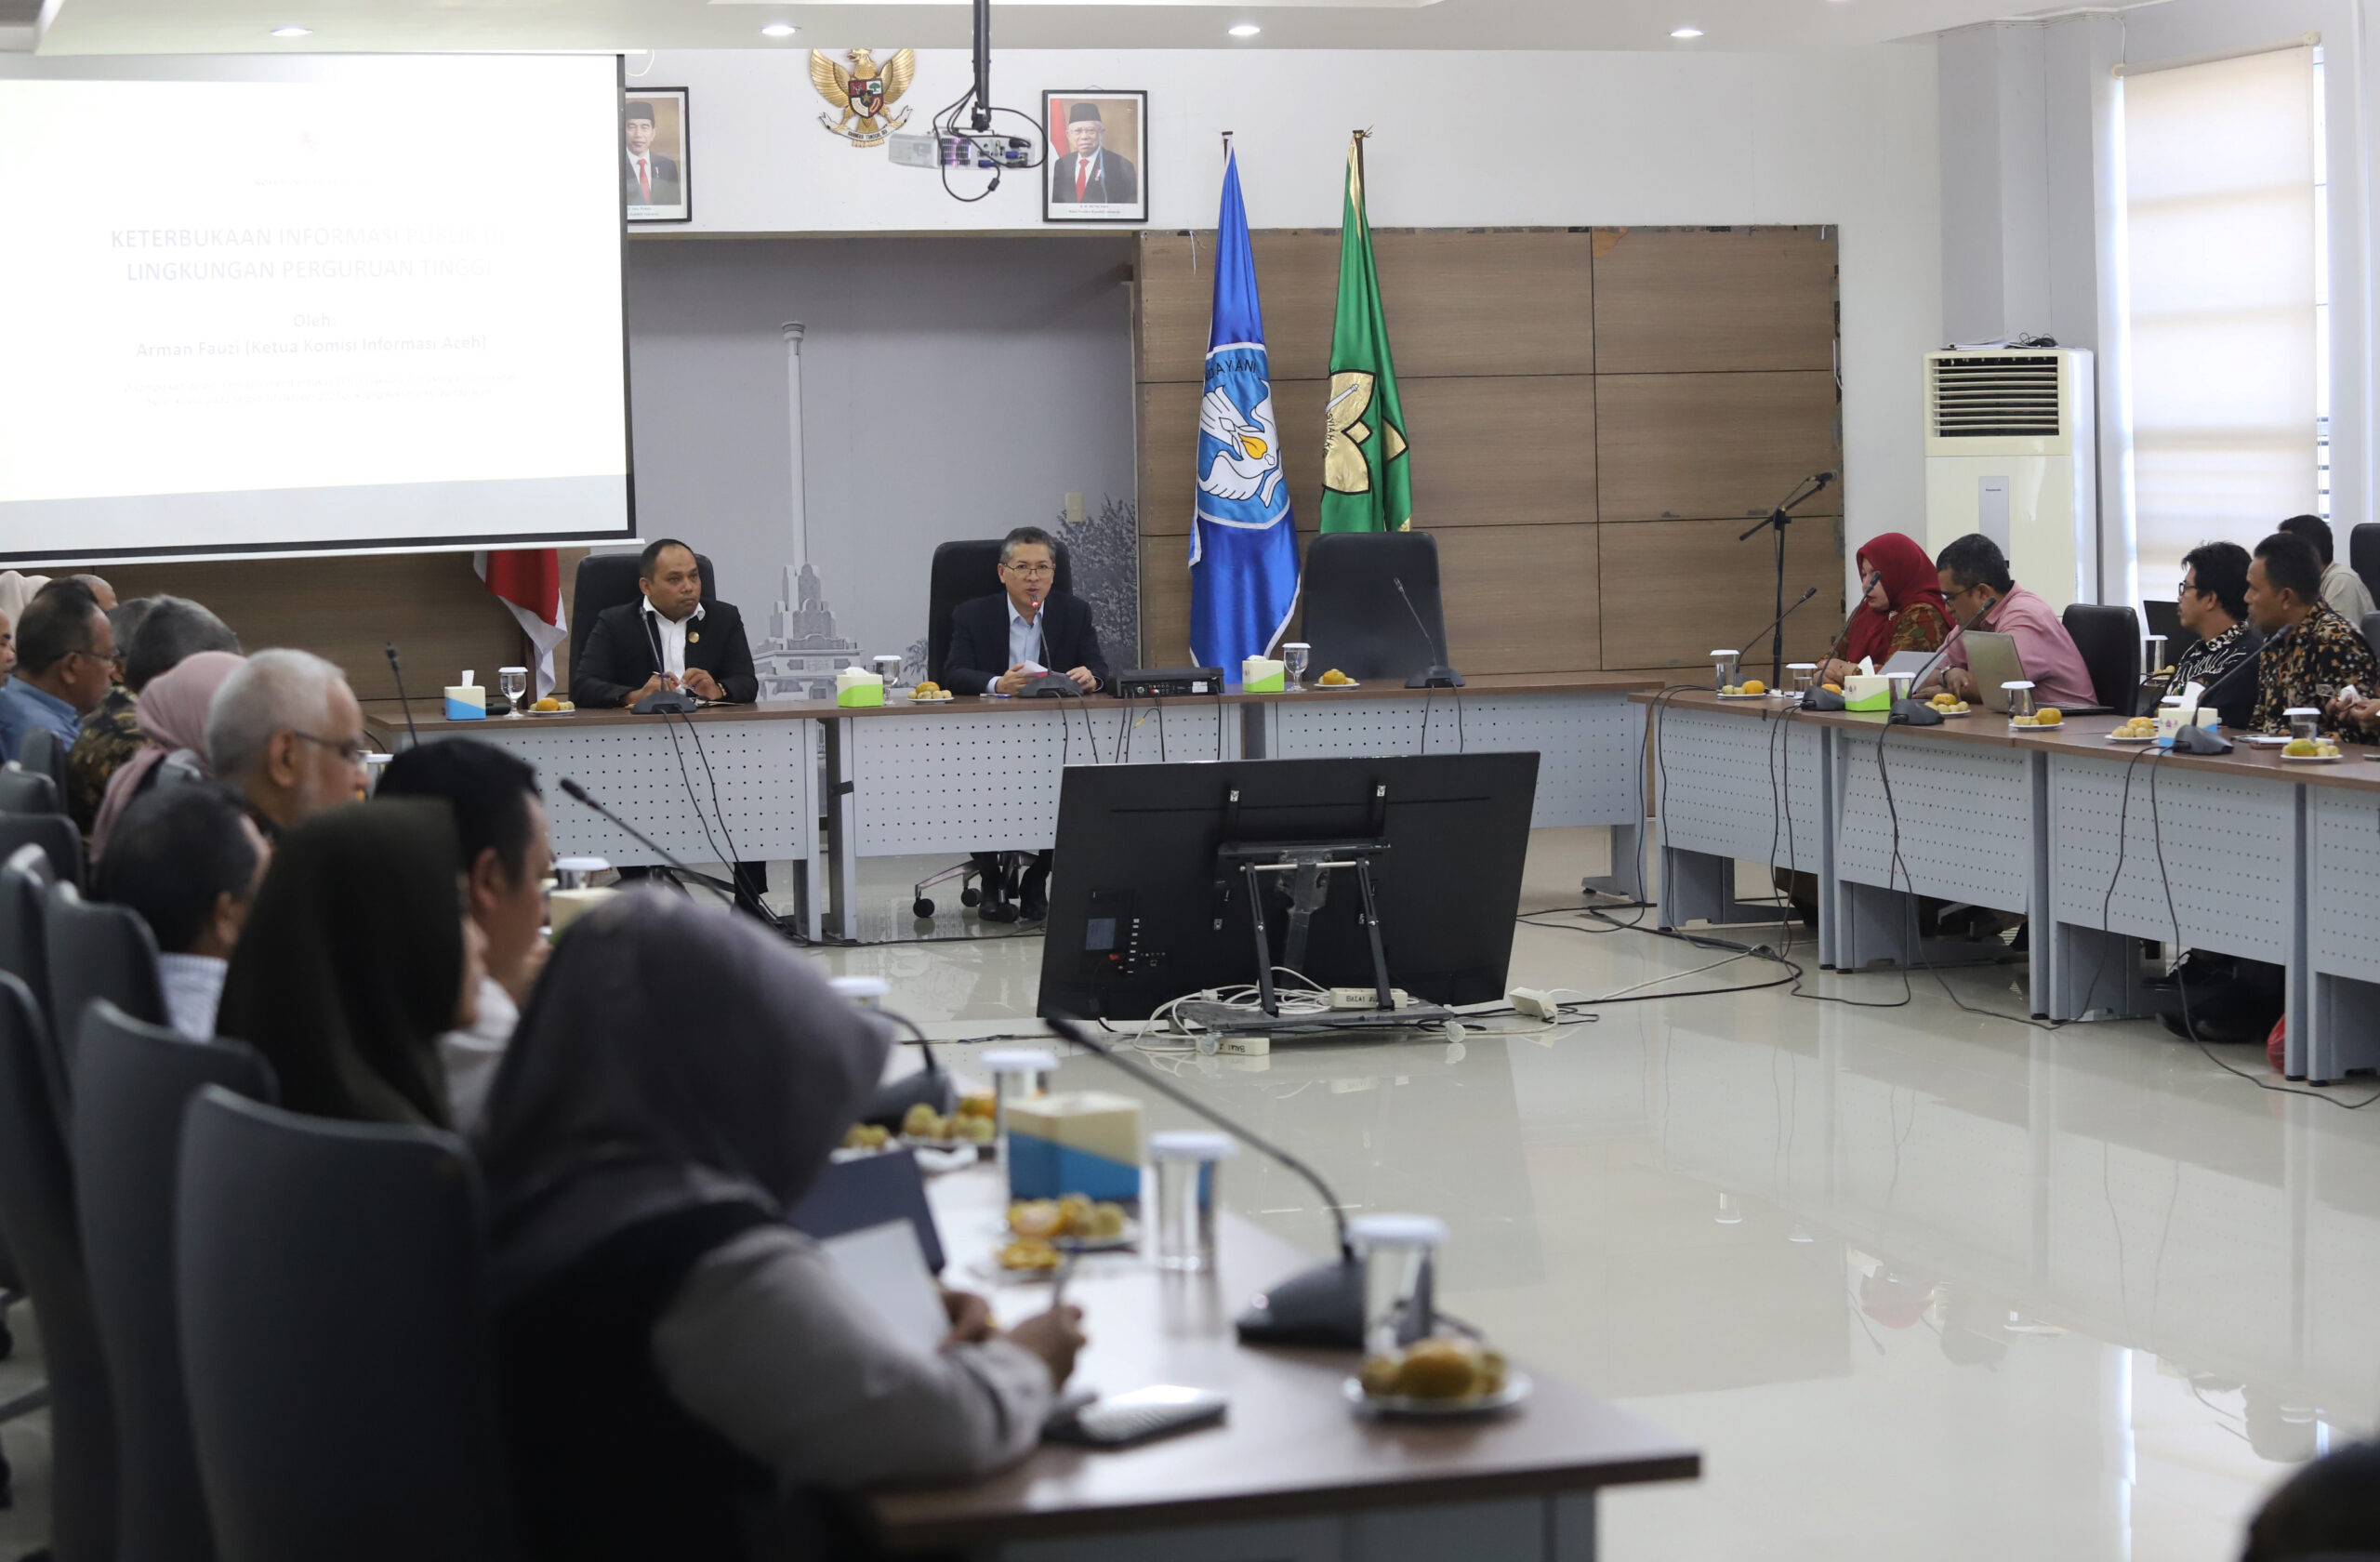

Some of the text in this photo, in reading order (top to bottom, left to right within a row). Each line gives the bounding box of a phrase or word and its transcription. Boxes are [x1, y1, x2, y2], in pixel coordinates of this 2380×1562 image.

[111, 228, 271, 248] KETERBUKAAN
[280, 226, 398, 246] INFORMASI
[127, 260, 274, 281] LINGKUNGAN
[282, 259, 412, 279] PERGURUAN
[136, 342, 192, 358] Arman
[198, 340, 239, 356] Fauzi
[245, 339, 298, 357] (Ketua
[304, 336, 357, 353] Komisi
[363, 336, 437, 351] Informasi
